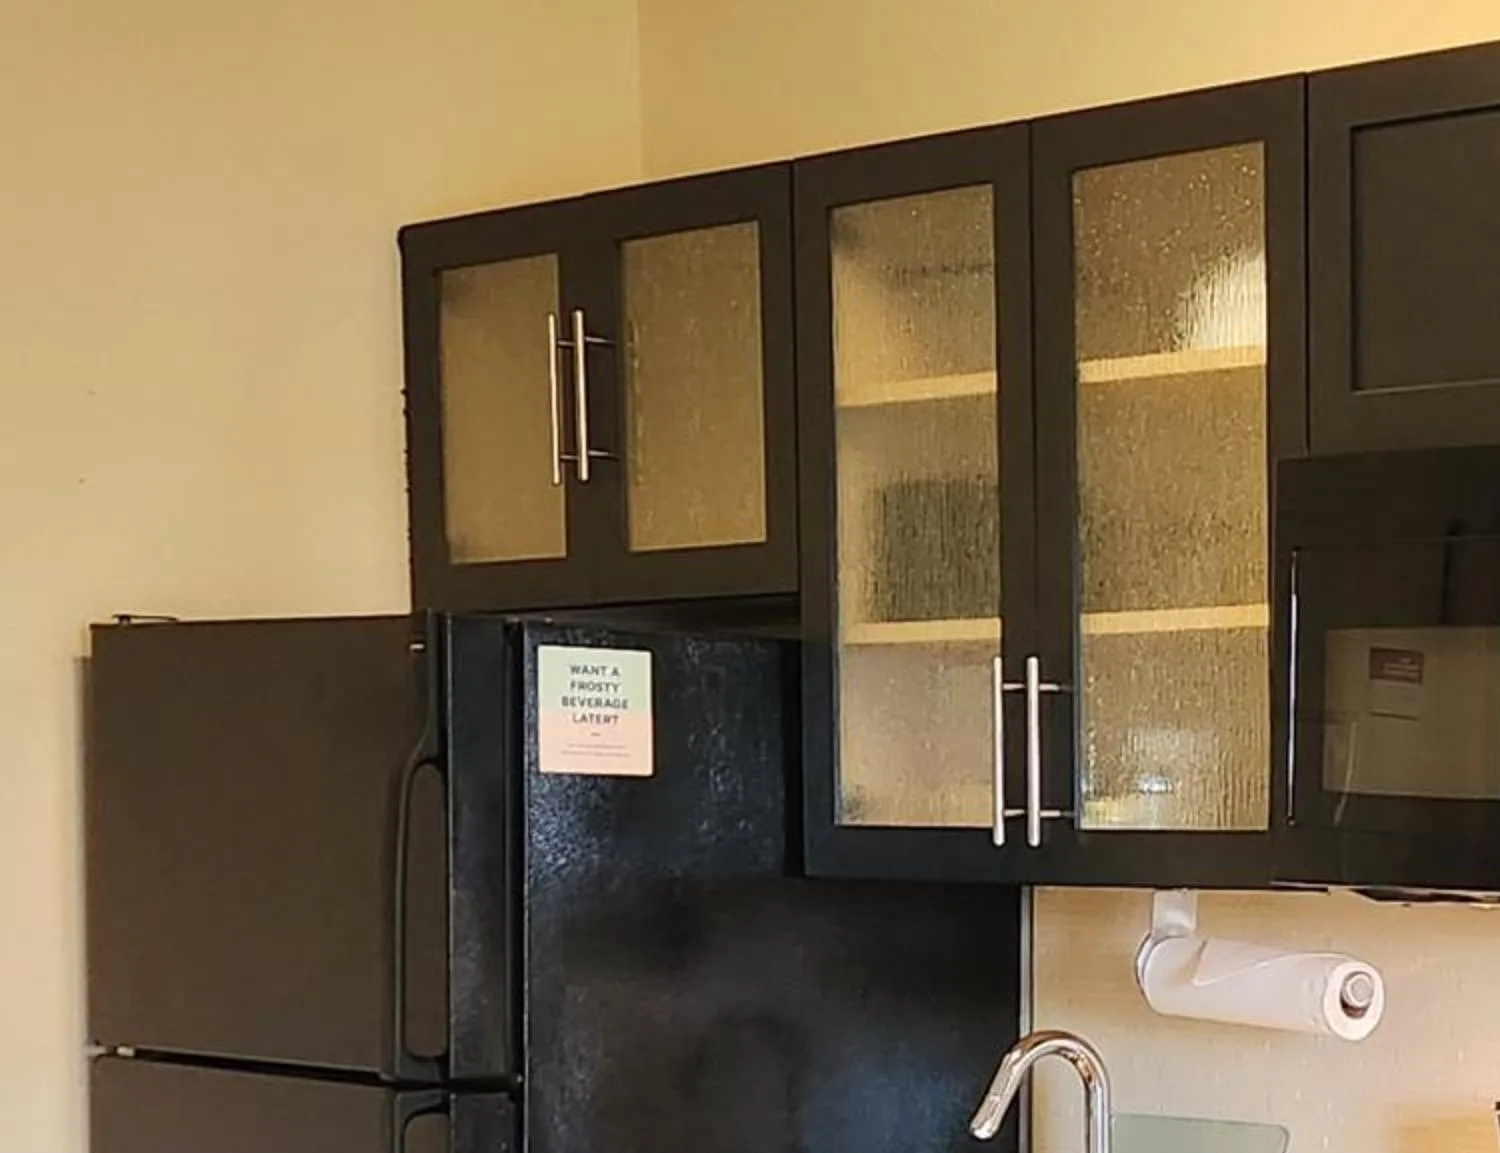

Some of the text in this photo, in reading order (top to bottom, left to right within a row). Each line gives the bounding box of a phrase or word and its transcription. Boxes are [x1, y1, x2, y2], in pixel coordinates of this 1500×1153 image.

[570, 665, 621, 677] WANT A
[569, 680, 621, 693] FROSTY
[561, 696, 629, 710] BEVERAGE
